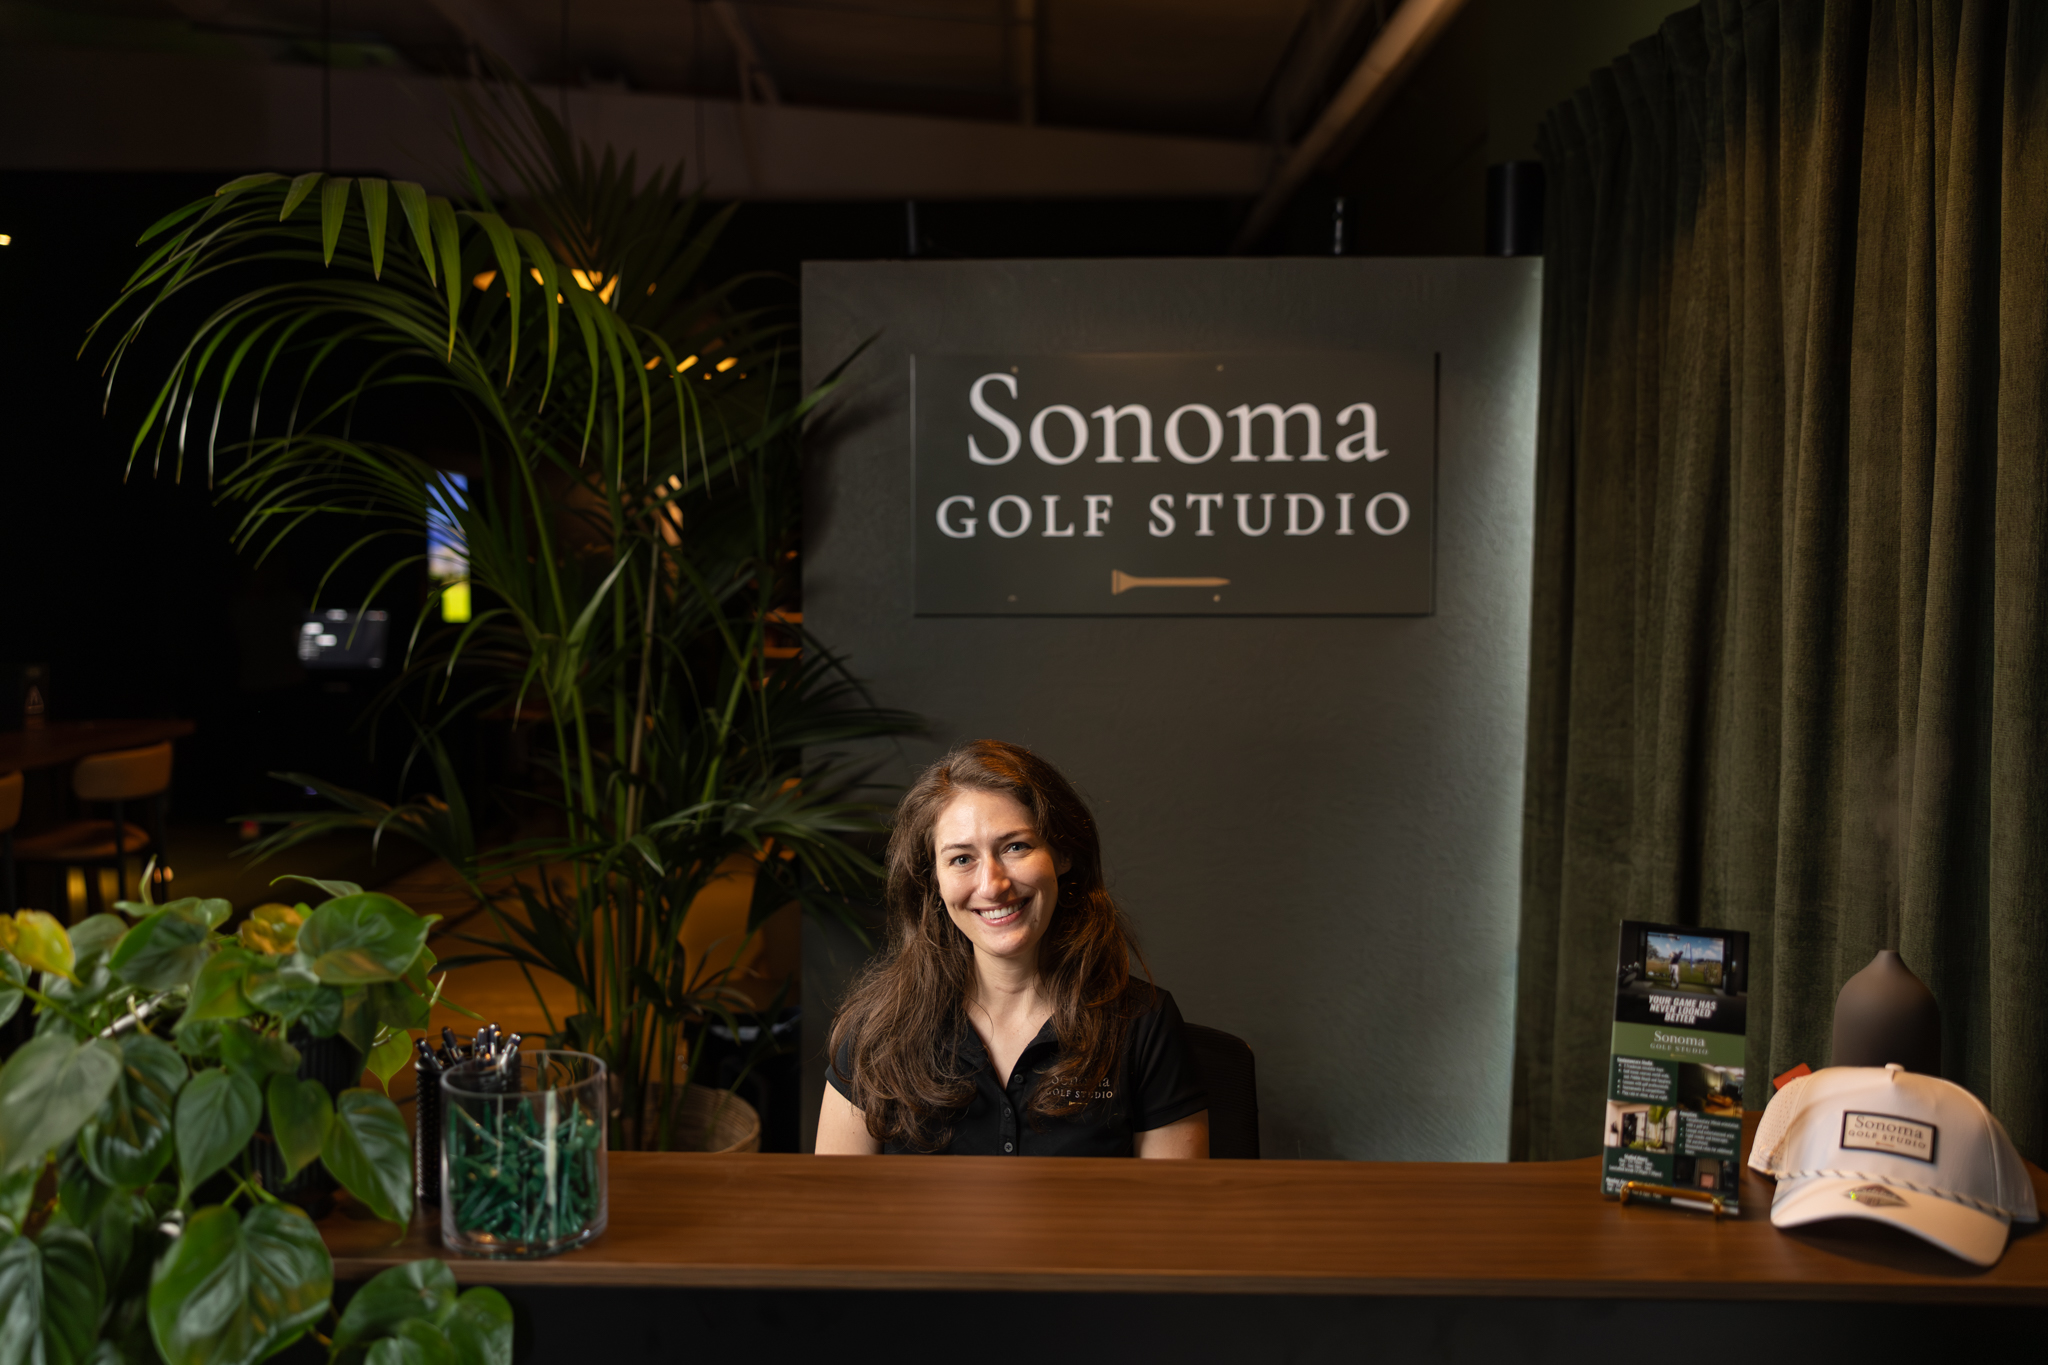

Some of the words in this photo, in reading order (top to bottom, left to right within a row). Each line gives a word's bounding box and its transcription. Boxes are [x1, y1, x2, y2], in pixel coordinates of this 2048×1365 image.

[967, 372, 1389, 467] Sonoma
[935, 494, 1114, 539] GOLF
[1148, 491, 1411, 538] STUDIO
[1648, 994, 1672, 1005] YOUR
[1673, 997, 1698, 1008] GAME
[1698, 1000, 1718, 1011] HAS
[1649, 1003, 1676, 1014] NEVER
[1677, 1005, 1712, 1018] LOOKED
[1664, 1012, 1696, 1024] BETTER
[1654, 1030, 1706, 1047] Sonoma
[1649, 1042, 1672, 1051] GOLF
[1675, 1045, 1708, 1055] STUDIO
[1854, 1115, 1923, 1139] Sonoma
[1848, 1129, 1877, 1139] GOLF
[1882, 1134, 1926, 1149] STUDIO
